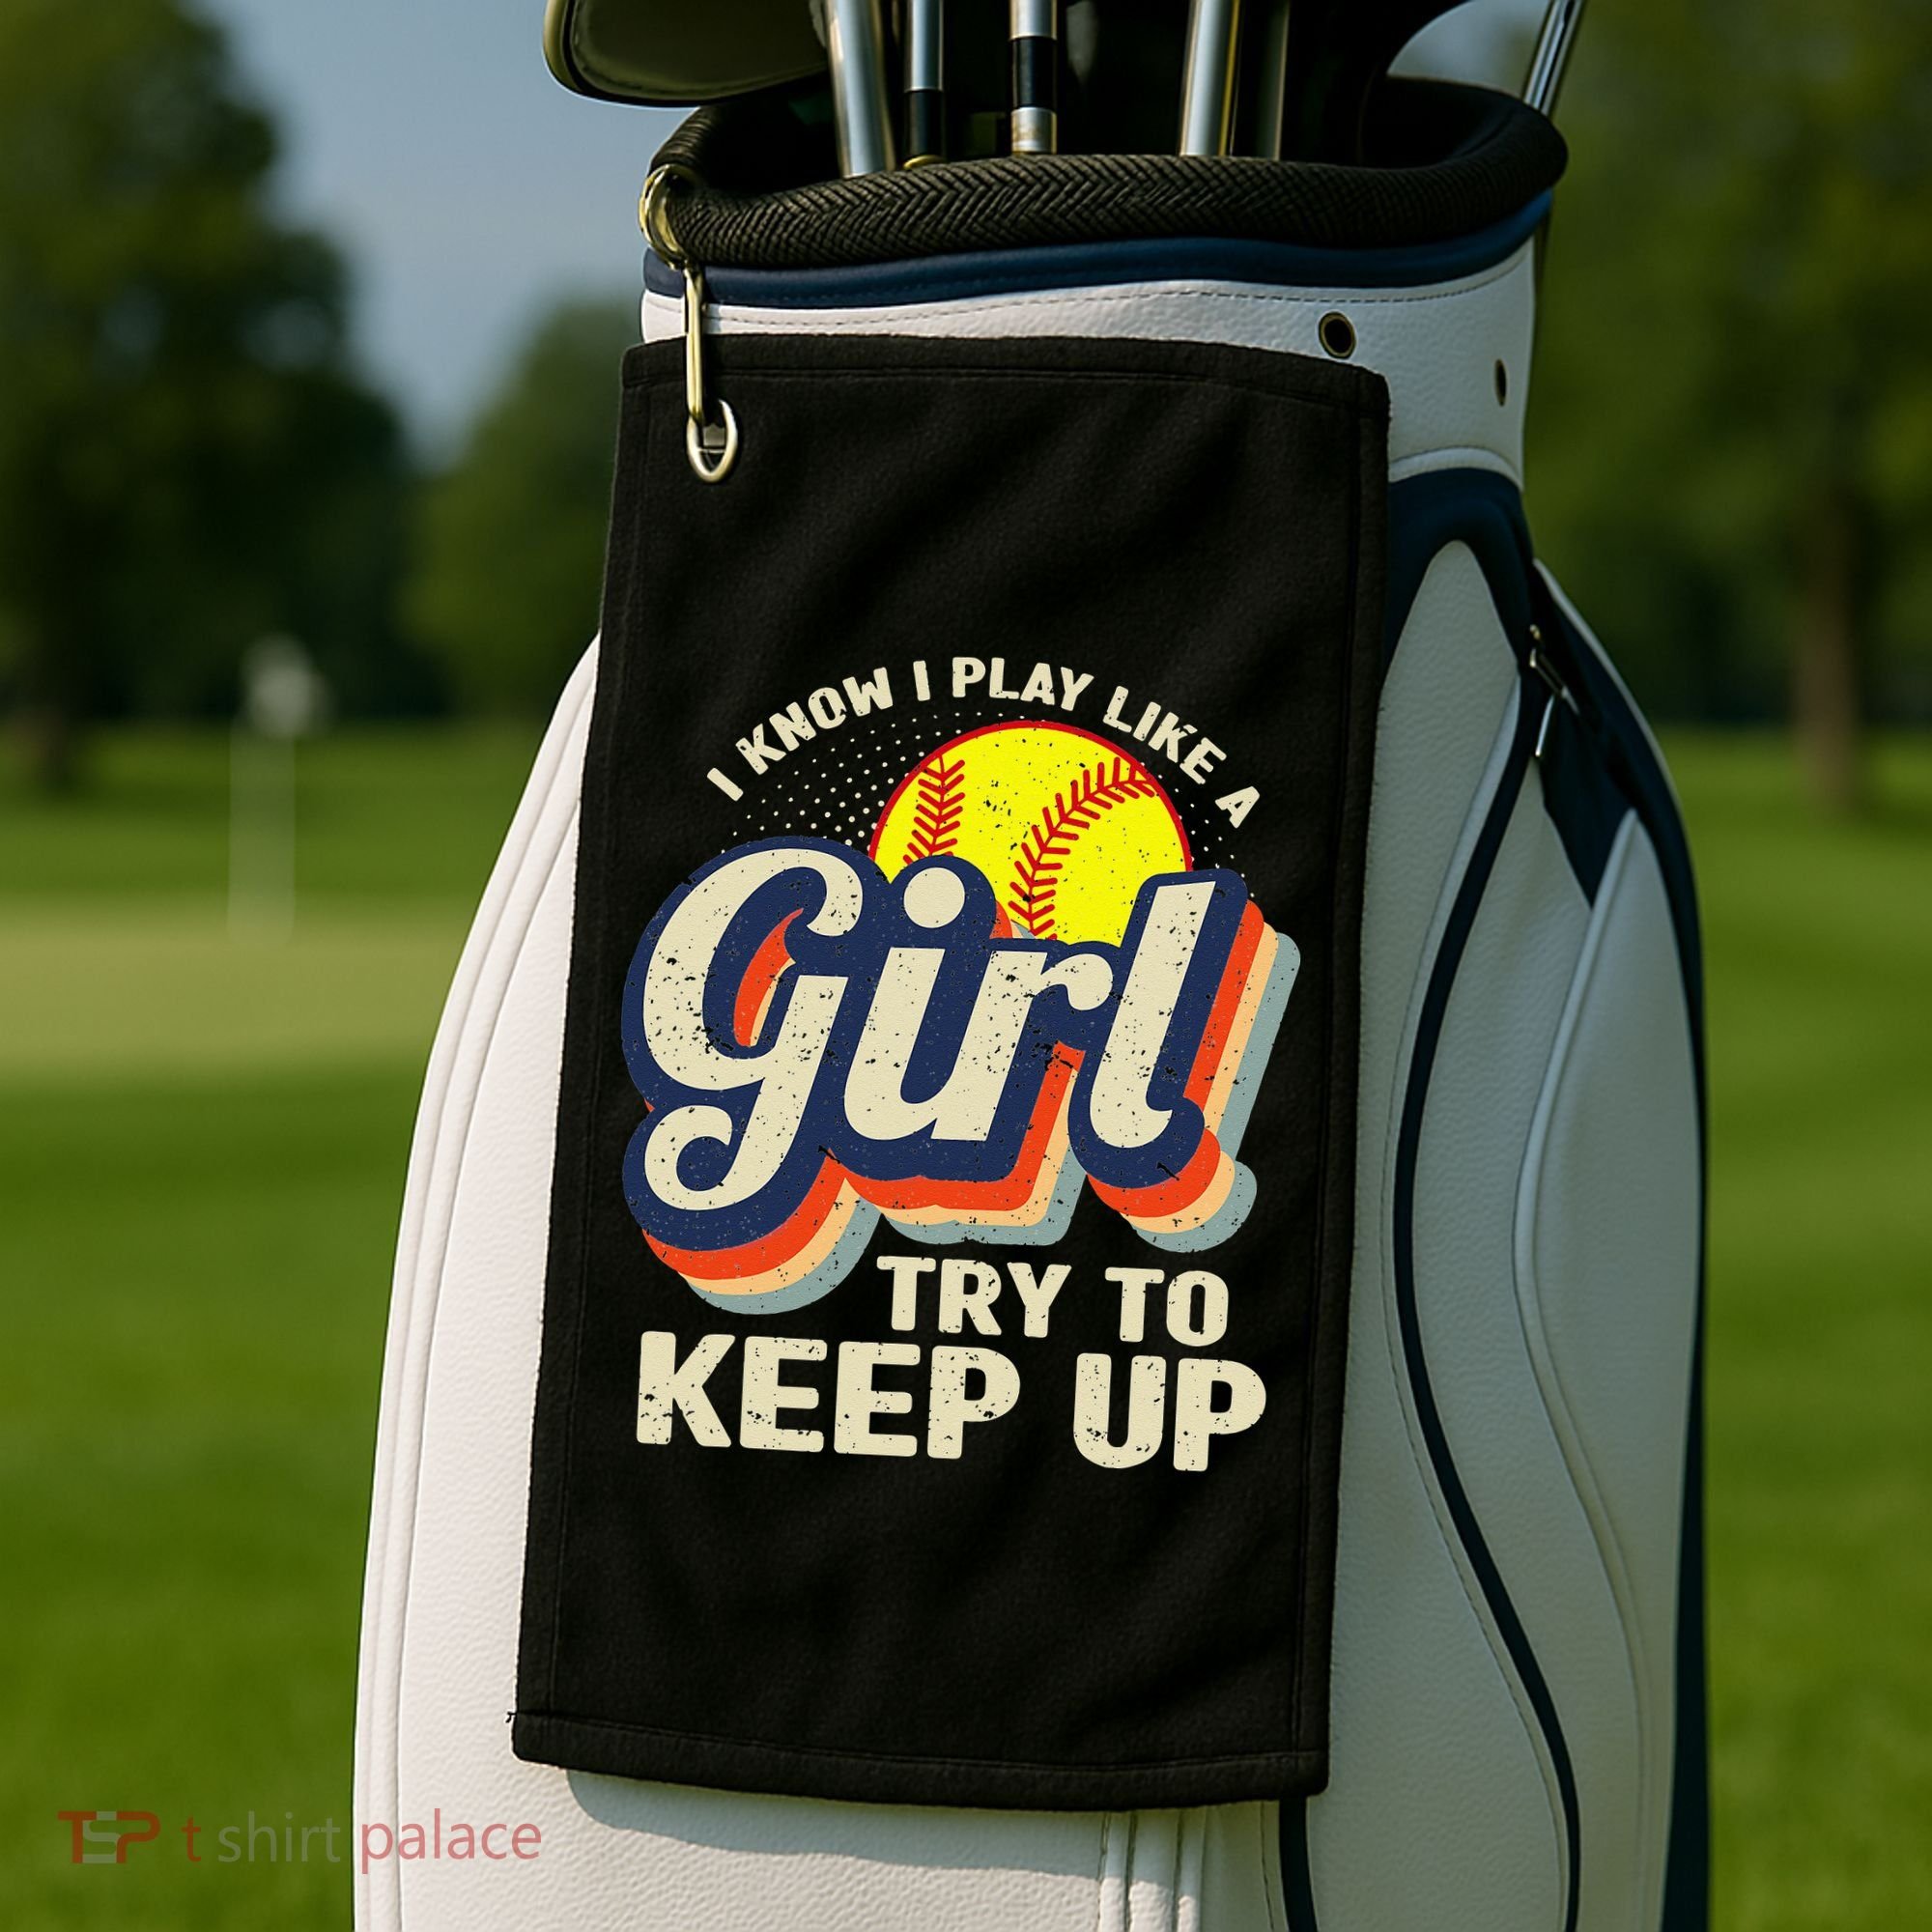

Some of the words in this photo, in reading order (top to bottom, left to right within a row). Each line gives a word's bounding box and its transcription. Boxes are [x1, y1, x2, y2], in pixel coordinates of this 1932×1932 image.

[706, 768, 744, 802] I
[734, 668, 894, 776] KNOW
[914, 660, 930, 701] I
[952, 656, 1094, 711] PLAY
[1102, 686, 1228, 785] LIKE
[1215, 785, 1261, 829] A
[624, 837, 1247, 1250] Girl
[877, 1256, 1070, 1338] TRY
[1105, 1266, 1229, 1347] TO
[636, 1331, 1020, 1460] KEEP
[1073, 1353, 1266, 1472] UP
